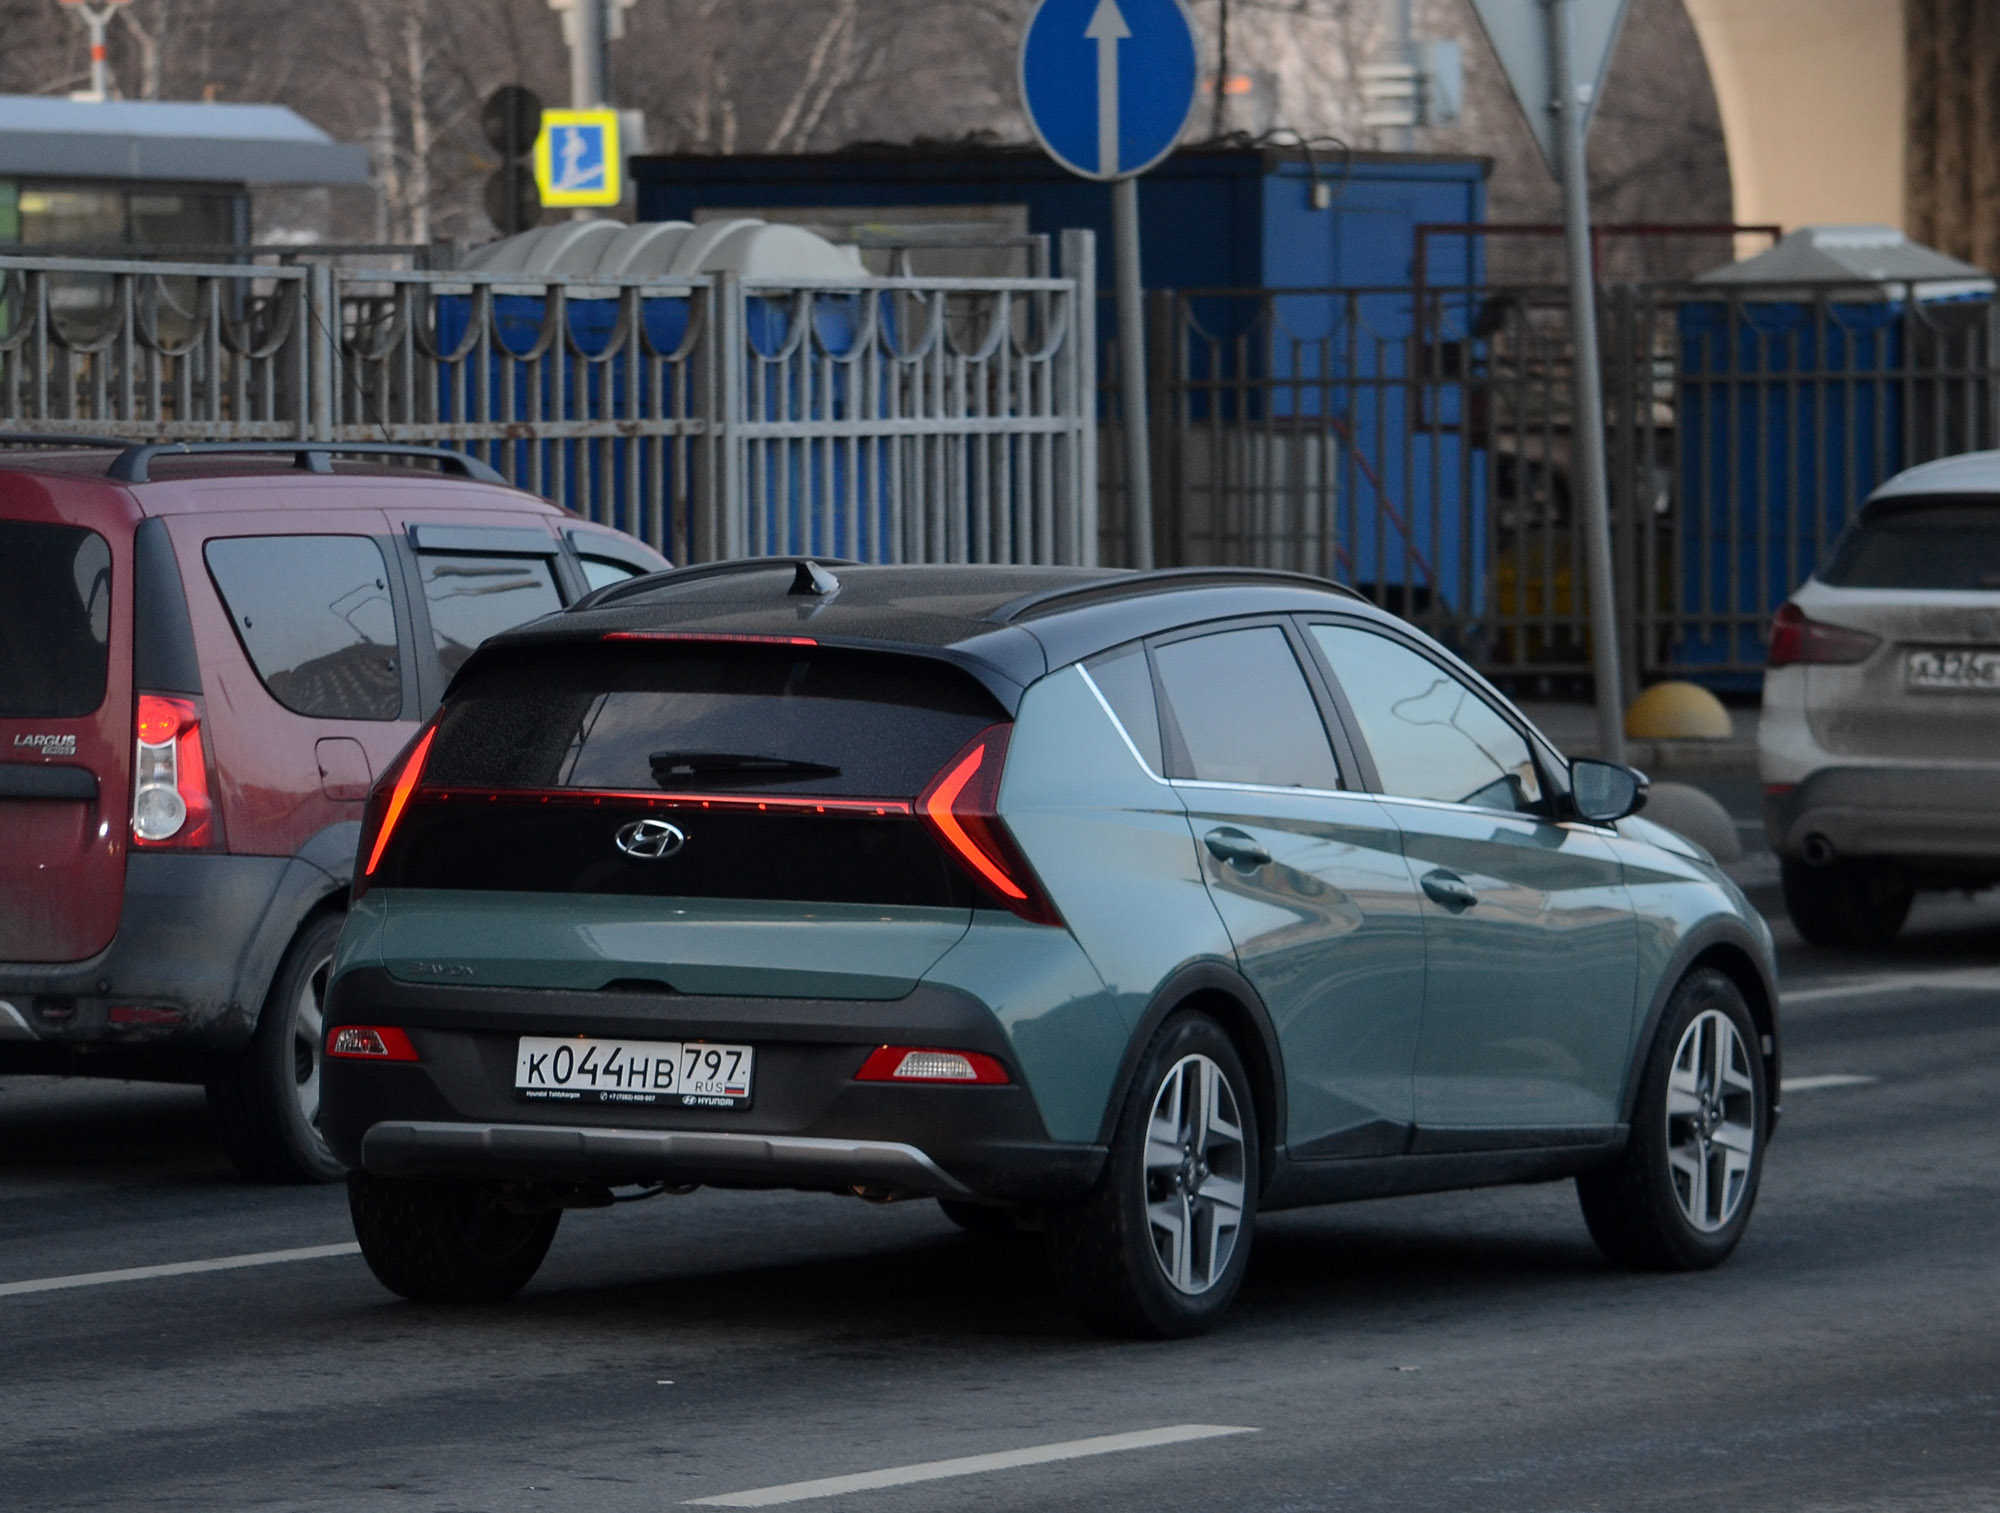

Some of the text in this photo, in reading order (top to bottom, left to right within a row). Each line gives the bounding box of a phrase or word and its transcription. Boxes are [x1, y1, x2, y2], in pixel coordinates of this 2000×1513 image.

[14, 734, 76, 747] LARGUS
[685, 1048, 743, 1082] 797
[695, 1081, 724, 1094] RUS
[697, 1096, 735, 1106] HYUNDAI
